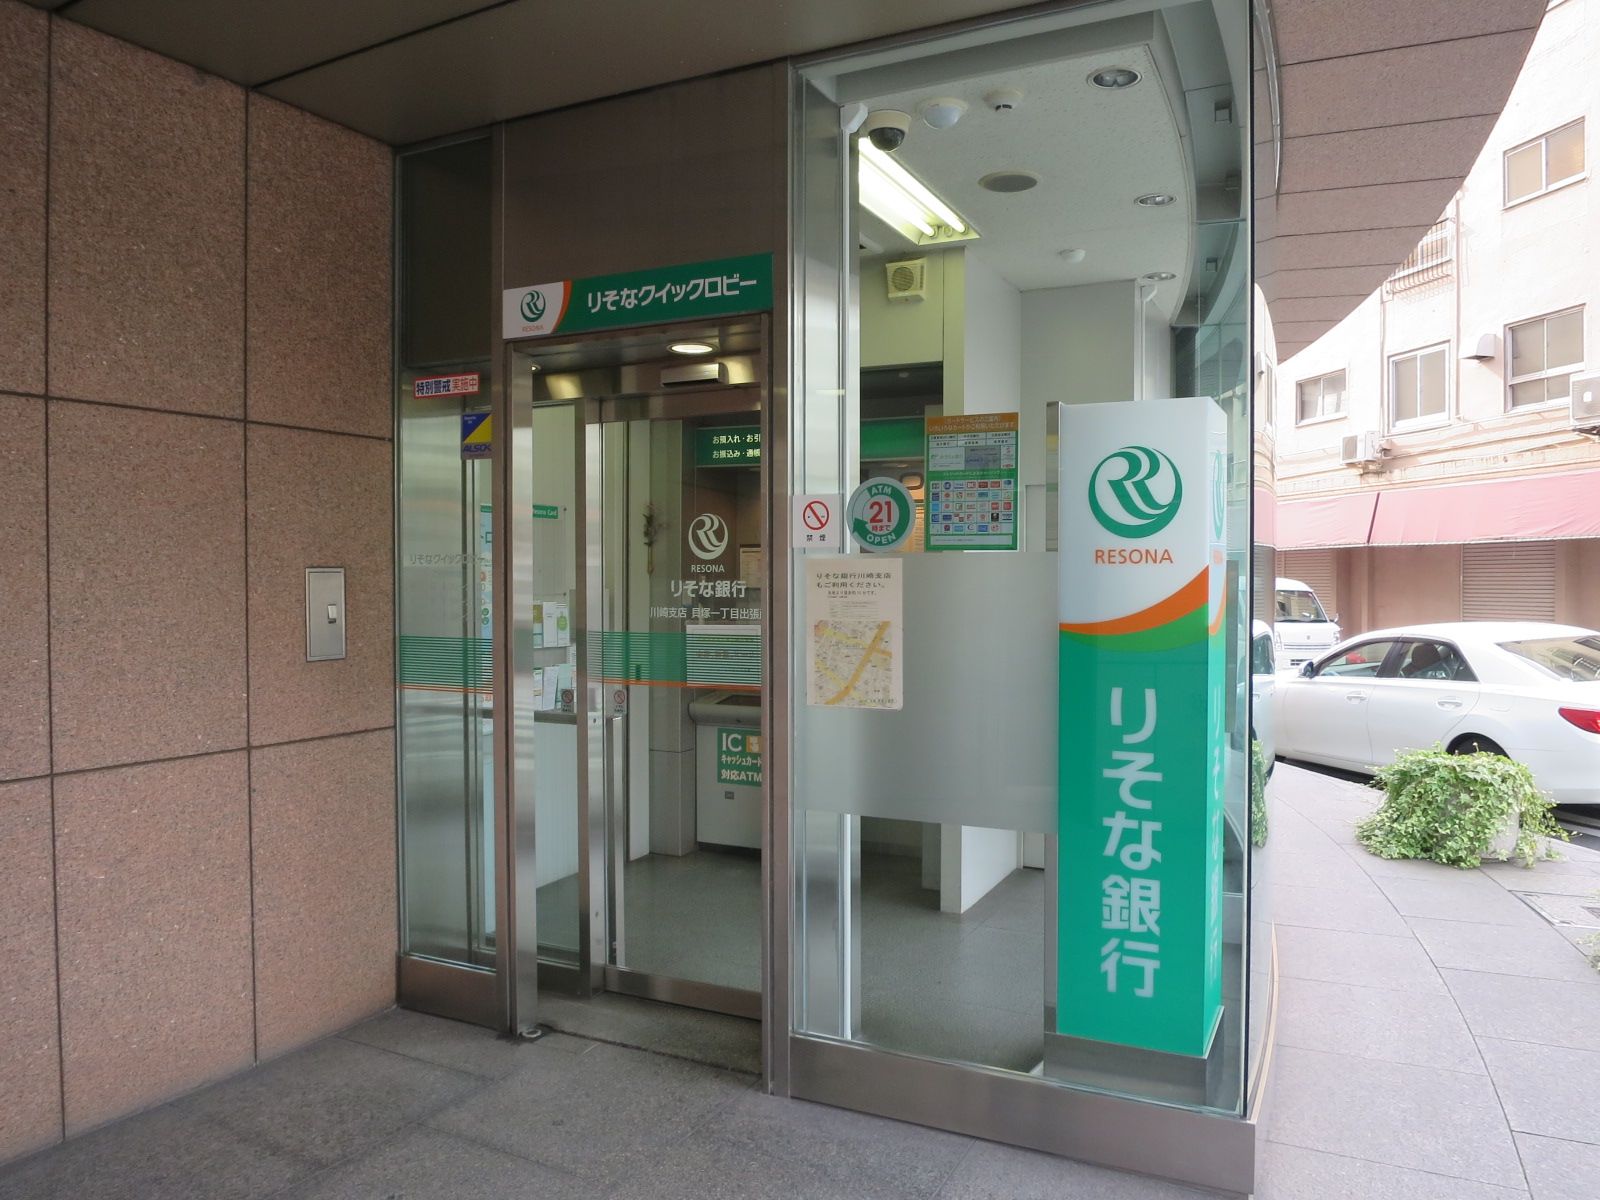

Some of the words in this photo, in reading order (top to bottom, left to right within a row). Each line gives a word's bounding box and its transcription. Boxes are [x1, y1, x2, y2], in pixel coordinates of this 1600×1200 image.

[587, 274, 757, 313] りそなクイックロビー
[416, 376, 478, 396] 特別警戒実施中
[871, 485, 892, 496] ATM
[869, 500, 893, 524] 21
[871, 524, 891, 532] 時まで
[866, 532, 897, 545] OPEN
[1094, 548, 1174, 565] RESONA
[691, 564, 725, 573] RESONA
[816, 572, 891, 580] りそな銀行川崎支店
[670, 580, 747, 598] りそな銀行
[817, 581, 885, 589] もご利用ください。
[650, 607, 687, 619] 川崎支店
[722, 733, 742, 752] IC
[1101, 687, 1163, 998] りそな銀行
